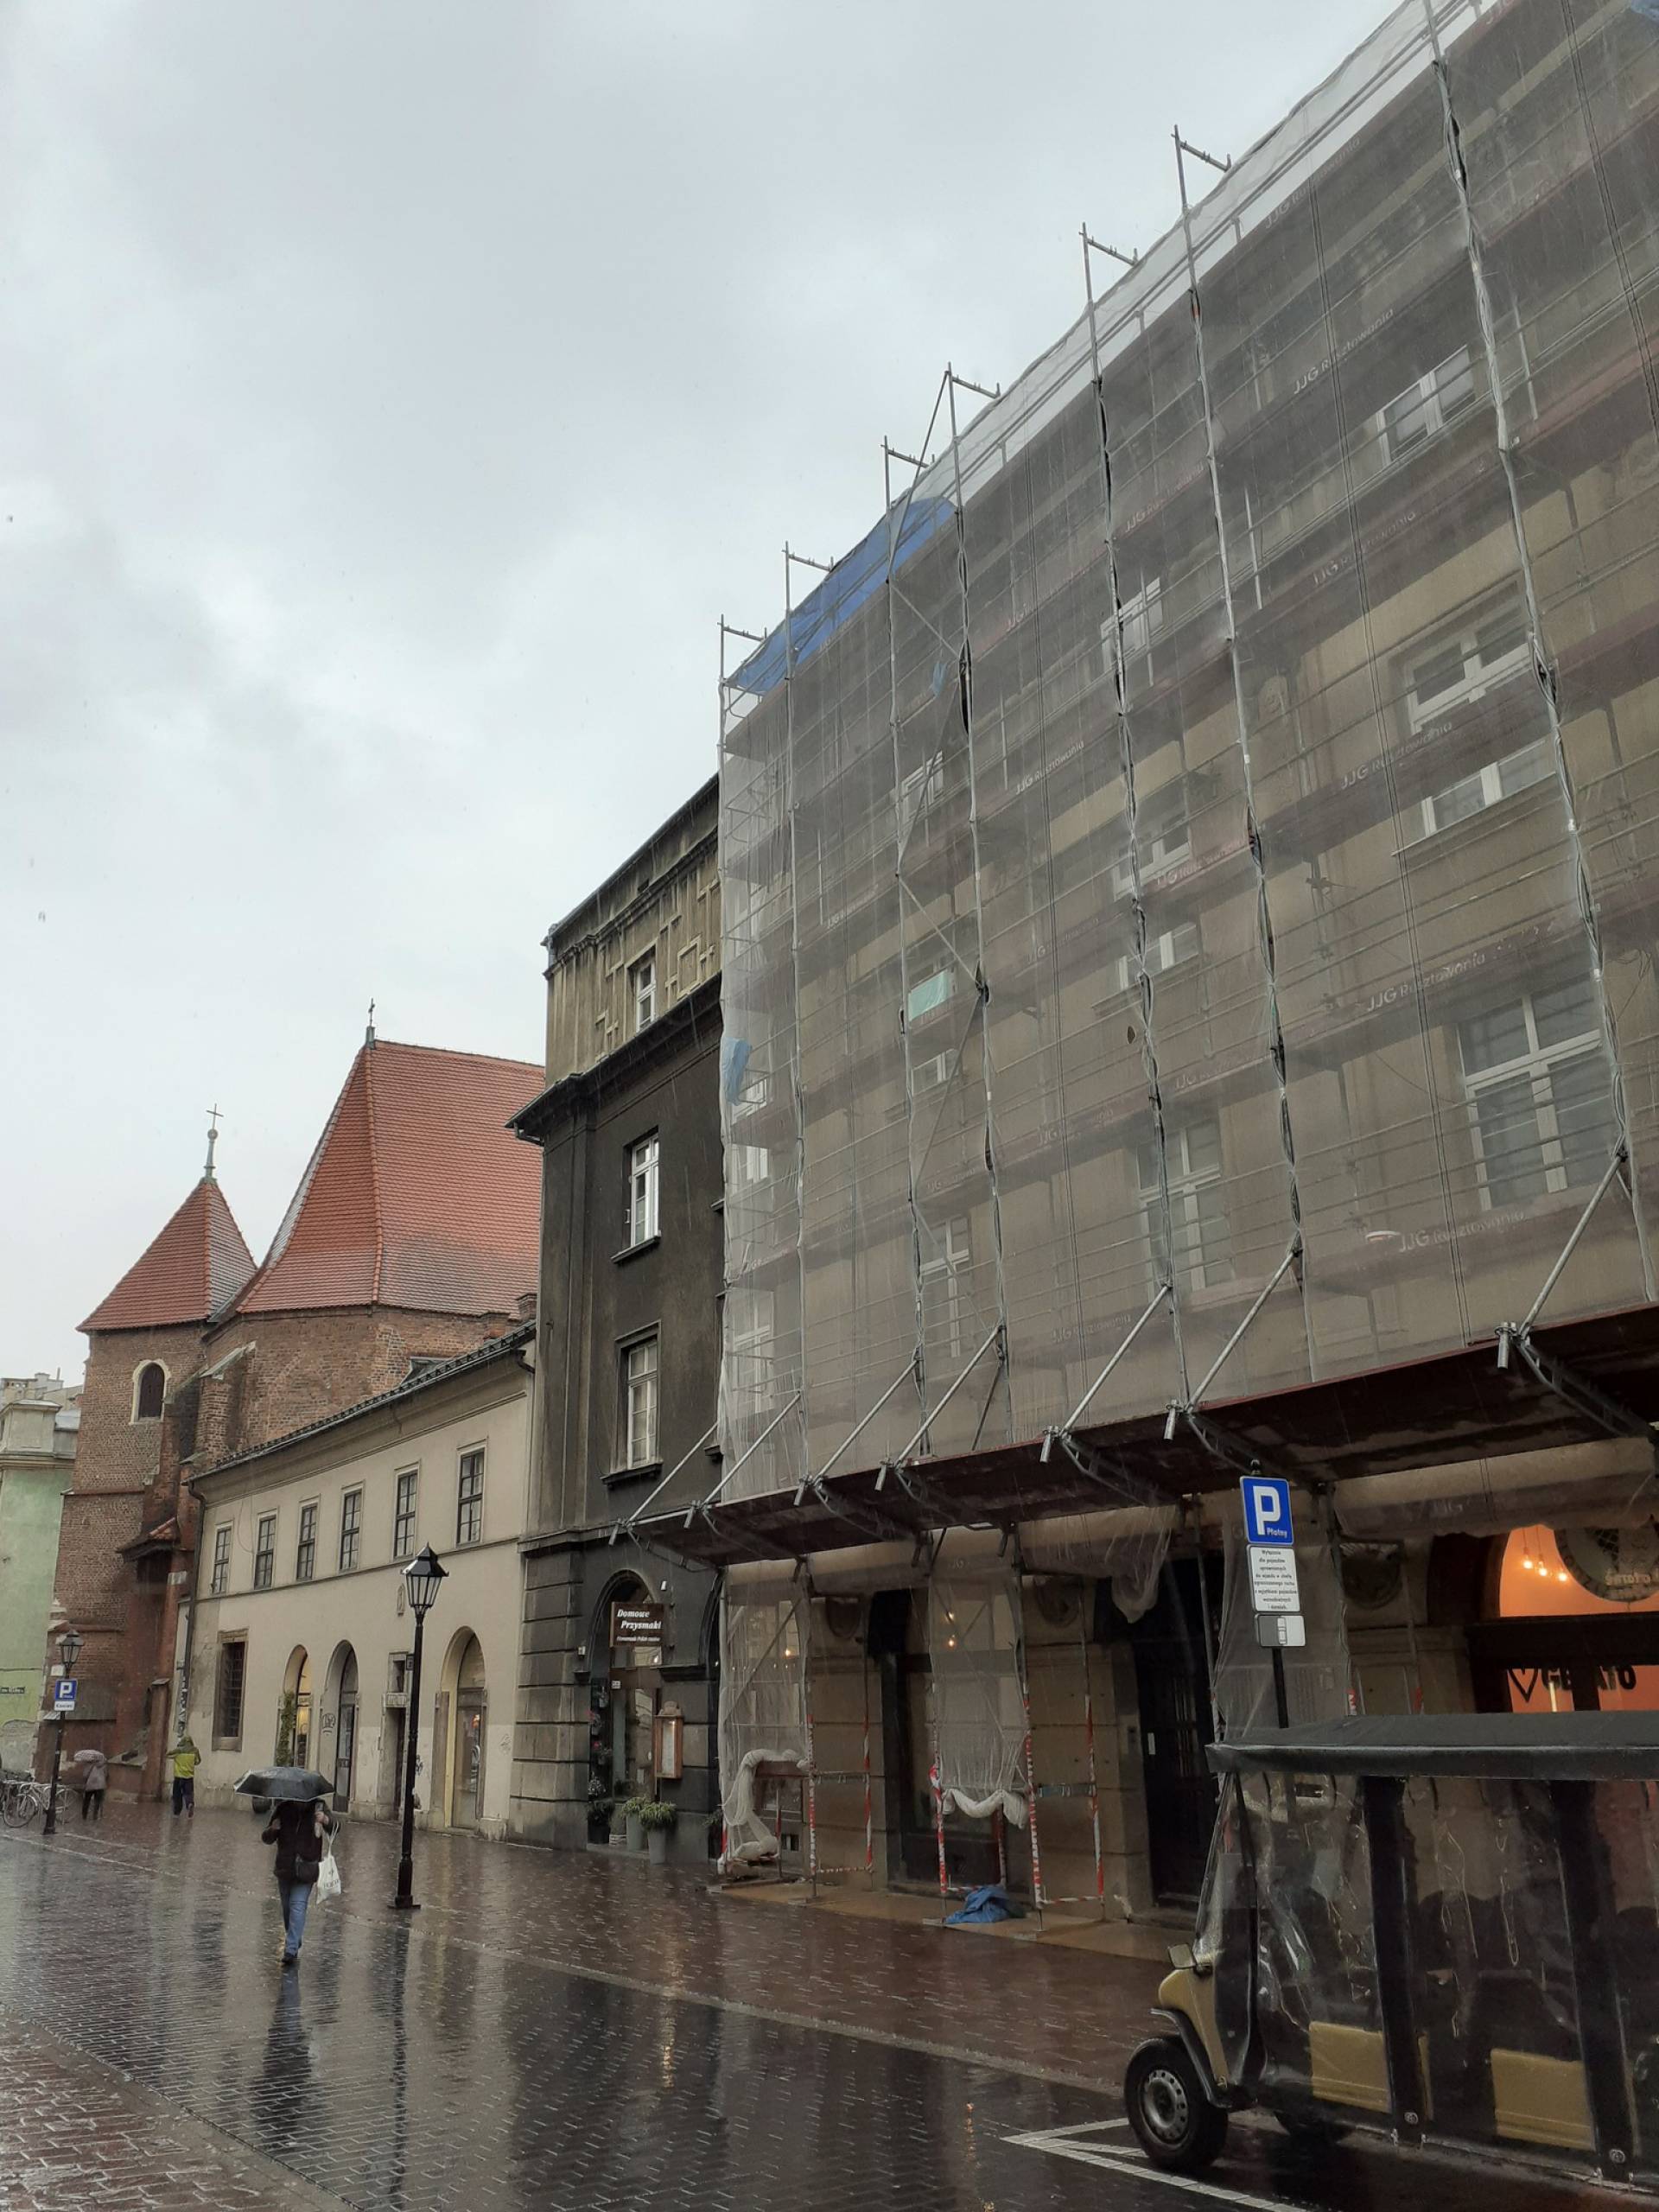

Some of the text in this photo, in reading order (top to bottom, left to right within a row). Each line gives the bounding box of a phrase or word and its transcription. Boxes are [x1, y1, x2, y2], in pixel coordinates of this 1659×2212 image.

[1294, 366, 1319, 394] JJG
[1341, 765, 1369, 790] JJG
[1367, 952, 1485, 1012] JJG Ruztowania
[1399, 1211, 1525, 1253] JJG Ruztowania
[1253, 1485, 1281, 1535] P
[617, 1609, 650, 1618] Domowe
[620, 1620, 662, 1631] Przysmaki
[60, 1681, 73, 1698] P
[1541, 1665, 1637, 1691] GEATO
